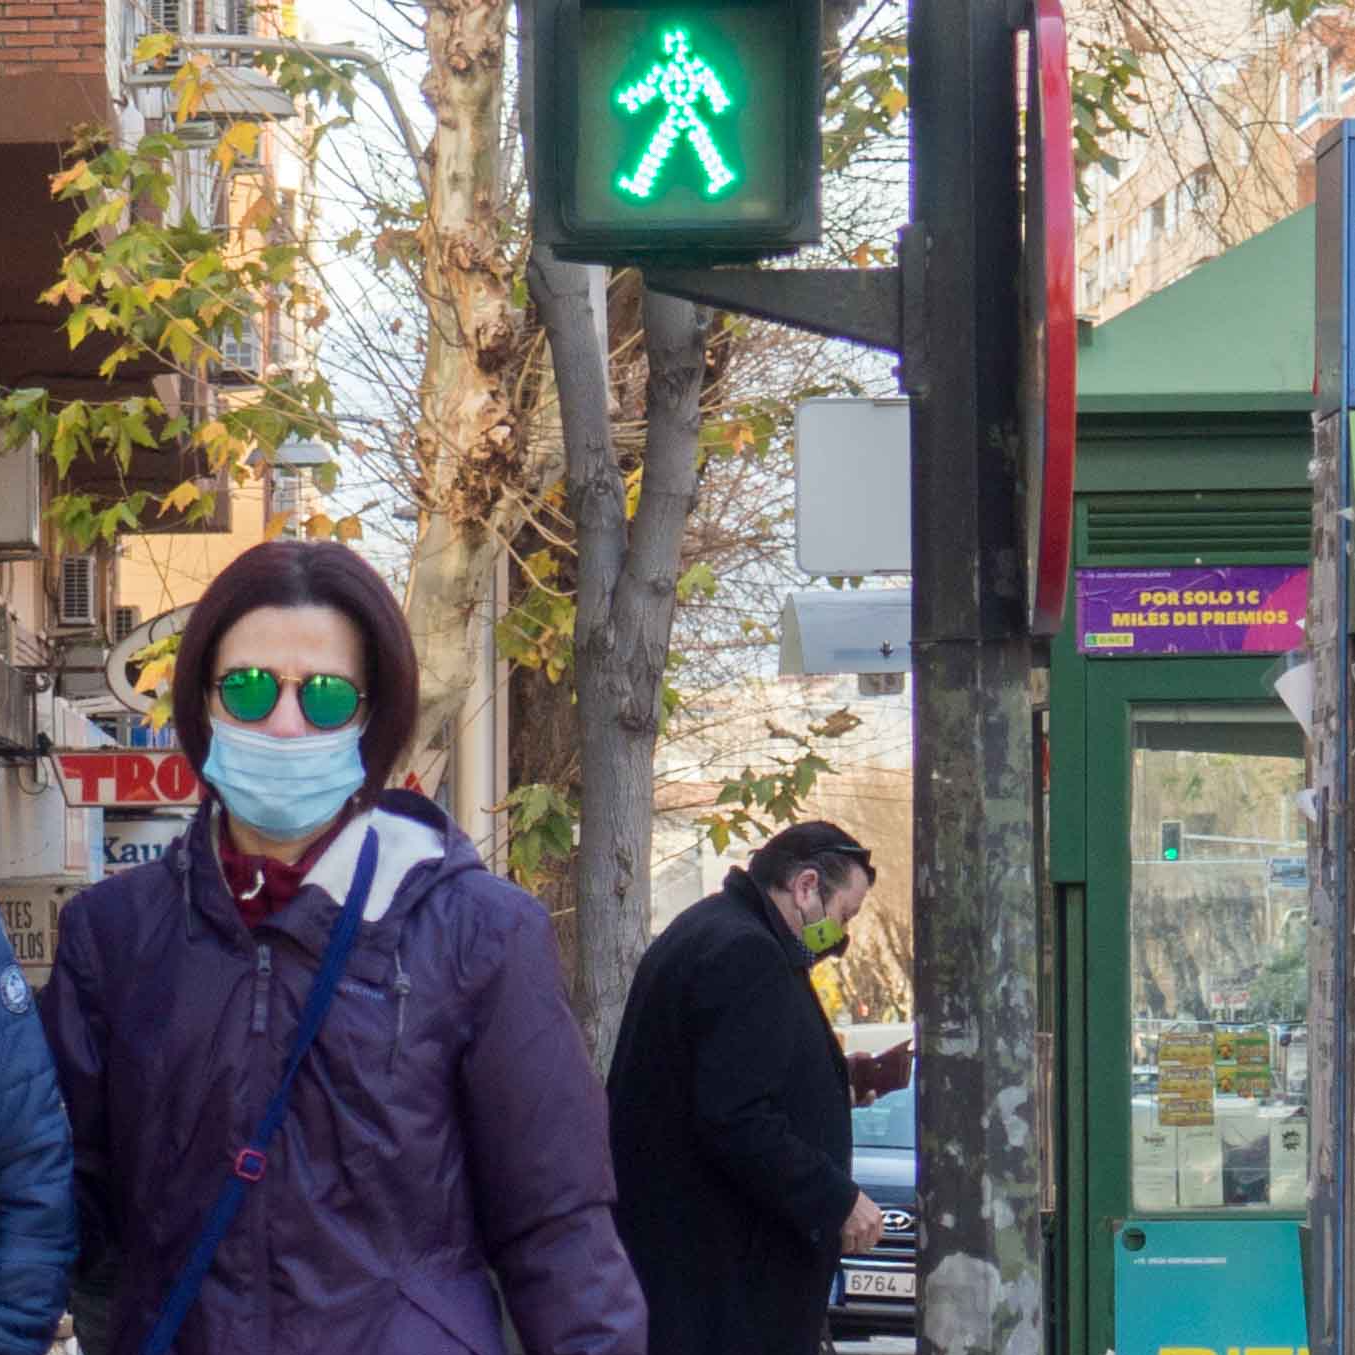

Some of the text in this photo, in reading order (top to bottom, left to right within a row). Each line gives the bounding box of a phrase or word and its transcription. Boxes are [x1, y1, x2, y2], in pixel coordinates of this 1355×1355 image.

[1140, 590, 1180, 606] POR
[1183, 590, 1233, 605] SOLO
[1111, 609, 1289, 627] MILES DE PREMIOS
[58, 754, 206, 802] TRO
[851, 1274, 897, 1292] 6764
